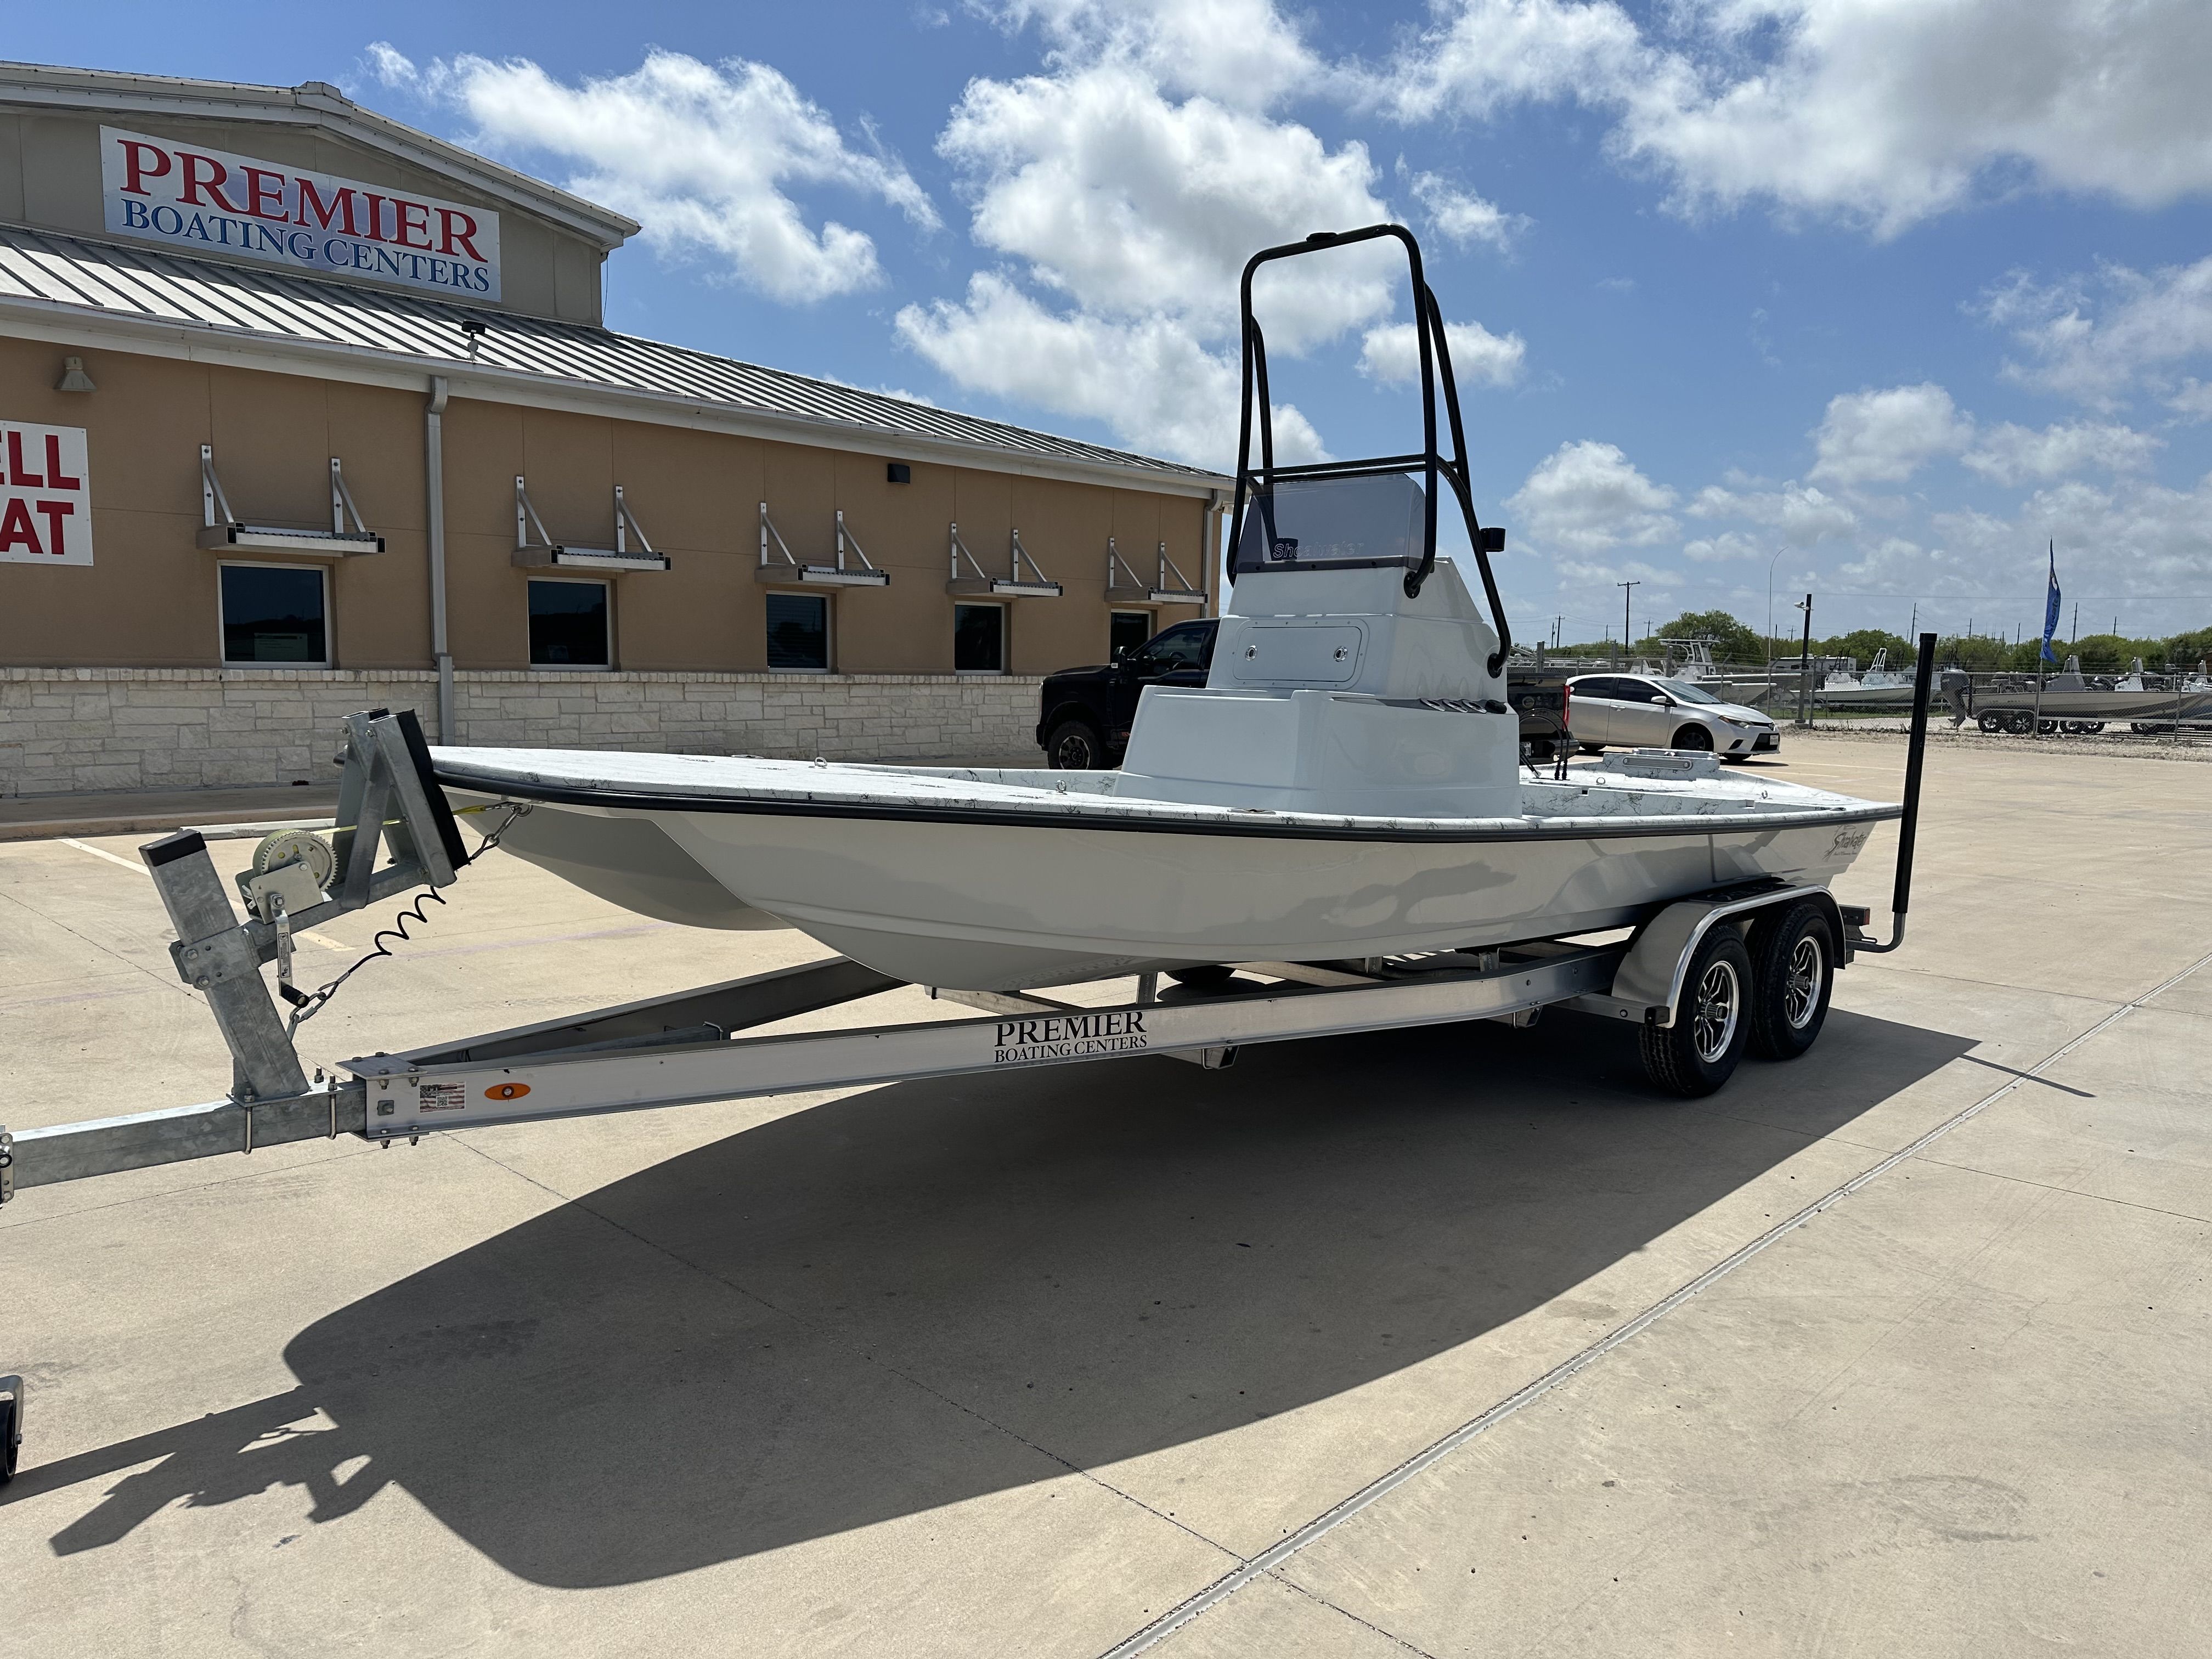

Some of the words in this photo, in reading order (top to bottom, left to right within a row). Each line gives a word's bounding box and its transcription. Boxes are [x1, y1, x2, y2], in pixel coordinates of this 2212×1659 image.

[117, 139, 488, 263] PREMIER
[121, 198, 317, 259] BOATING
[323, 238, 490, 292] CENTERS
[0, 430, 80, 490] LL
[994, 1011, 1147, 1047] PREMIER
[994, 1043, 1072, 1063] BOATING
[1074, 1035, 1148, 1054] CENTERS
